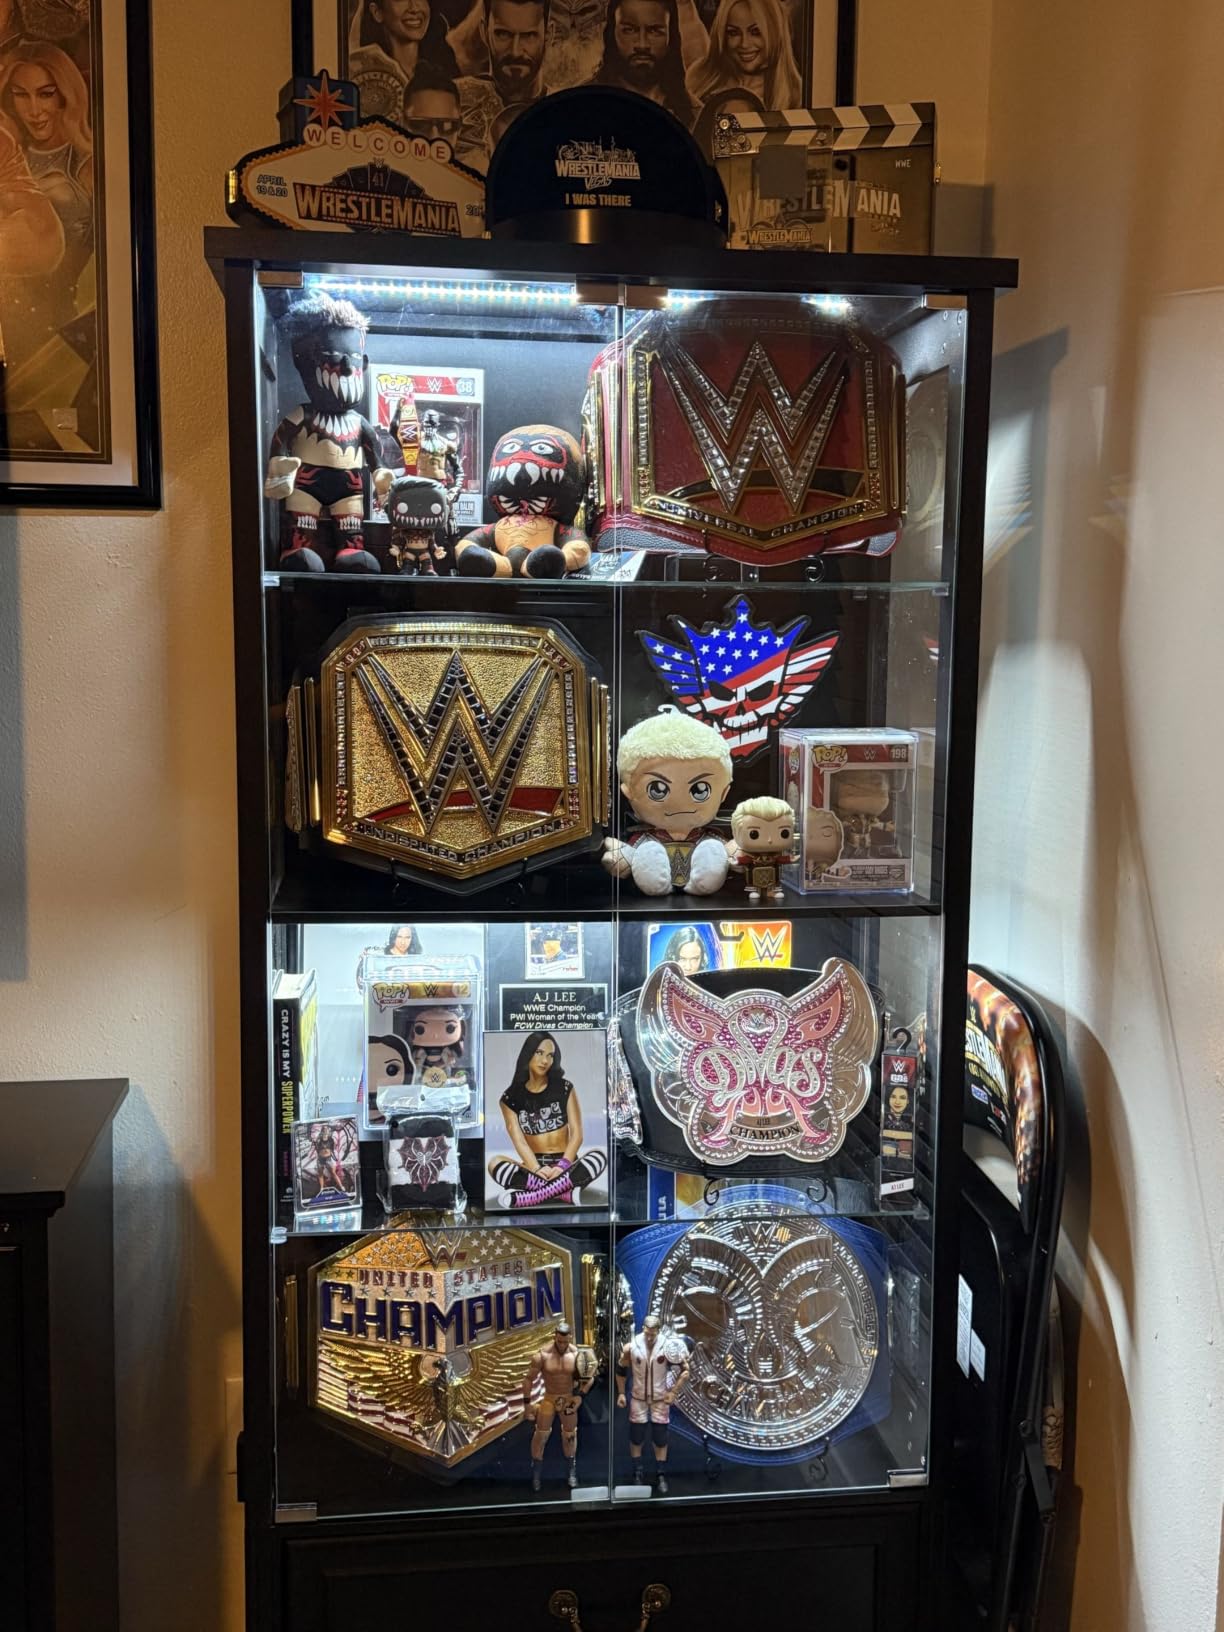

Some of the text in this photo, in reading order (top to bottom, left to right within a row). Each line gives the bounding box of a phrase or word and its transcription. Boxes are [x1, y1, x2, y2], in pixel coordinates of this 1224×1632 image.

[307, 127, 446, 157] WELCOME
[555, 160, 641, 180] WRESTLEMANIA
[895, 159, 911, 169] WWE
[257, 174, 287, 186] APRIL
[372, 172, 384, 187] 41
[256, 185, 267, 195] 19
[276, 187, 288, 198] 20
[565, 193, 632, 207] I WAS THERE
[297, 186, 460, 234] WRESTLEMANIA
[459, 381, 473, 393] 38
[770, 505, 859, 538] CHAMPION
[812, 745, 847, 763] POP!
[890, 748, 907, 760] 198
[366, 821, 556, 863] UNDISPUTED CHAMPION
[373, 983, 409, 999] POP!
[532, 991, 577, 1002] AJ LEE
[523, 1004, 586, 1013] WWE Champion
[510, 1013, 526, 1021] PWI
[527, 1013, 556, 1021] Woman
[558, 1013, 565, 1021] of
[567, 1013, 579, 1021] the
[514, 1021, 594, 1031] FCW Divas Champion
[281, 1009, 291, 1078] CRAZY IS MY
[281, 1080, 294, 1134] SUPERPOWER
[730, 1125, 799, 1140] CHAMPION
[359, 1259, 524, 1289] UNITED STATES
[320, 1262, 564, 1350] CHAMPION
